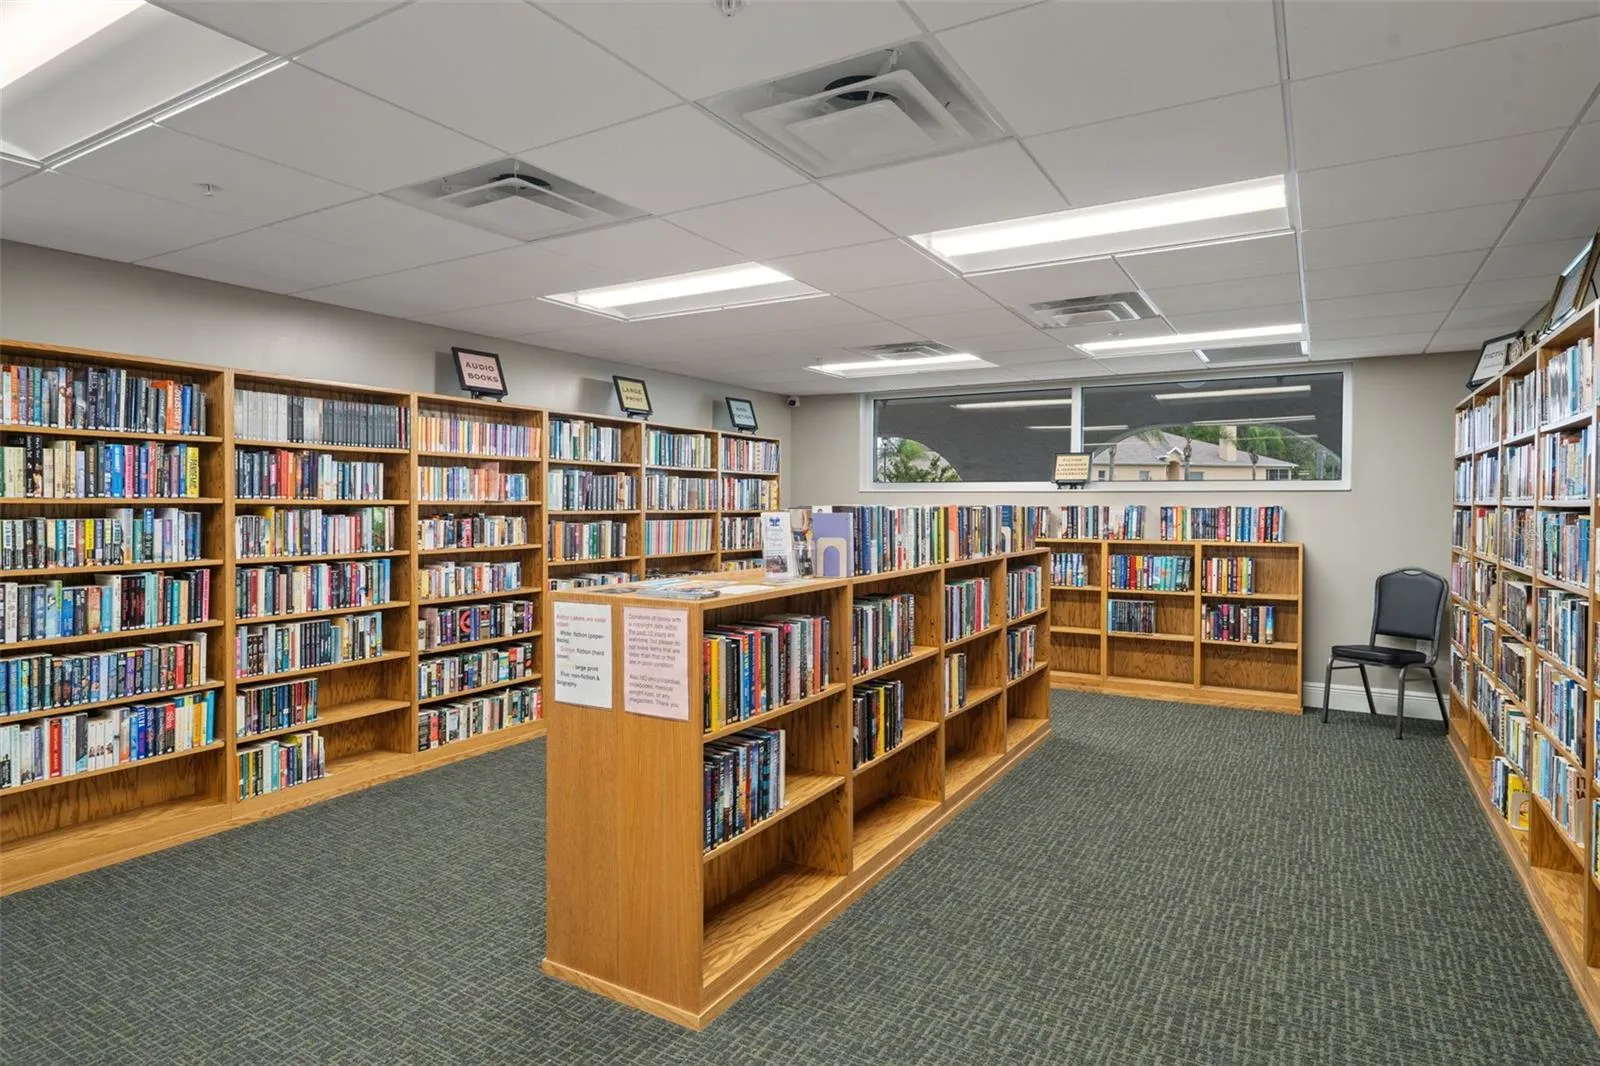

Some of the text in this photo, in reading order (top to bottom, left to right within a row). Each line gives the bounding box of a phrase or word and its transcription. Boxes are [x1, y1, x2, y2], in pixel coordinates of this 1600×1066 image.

[466, 362, 494, 372] AUDIO
[468, 372, 499, 383] BOOKS
[189, 459, 198, 489] PANDEMIC
